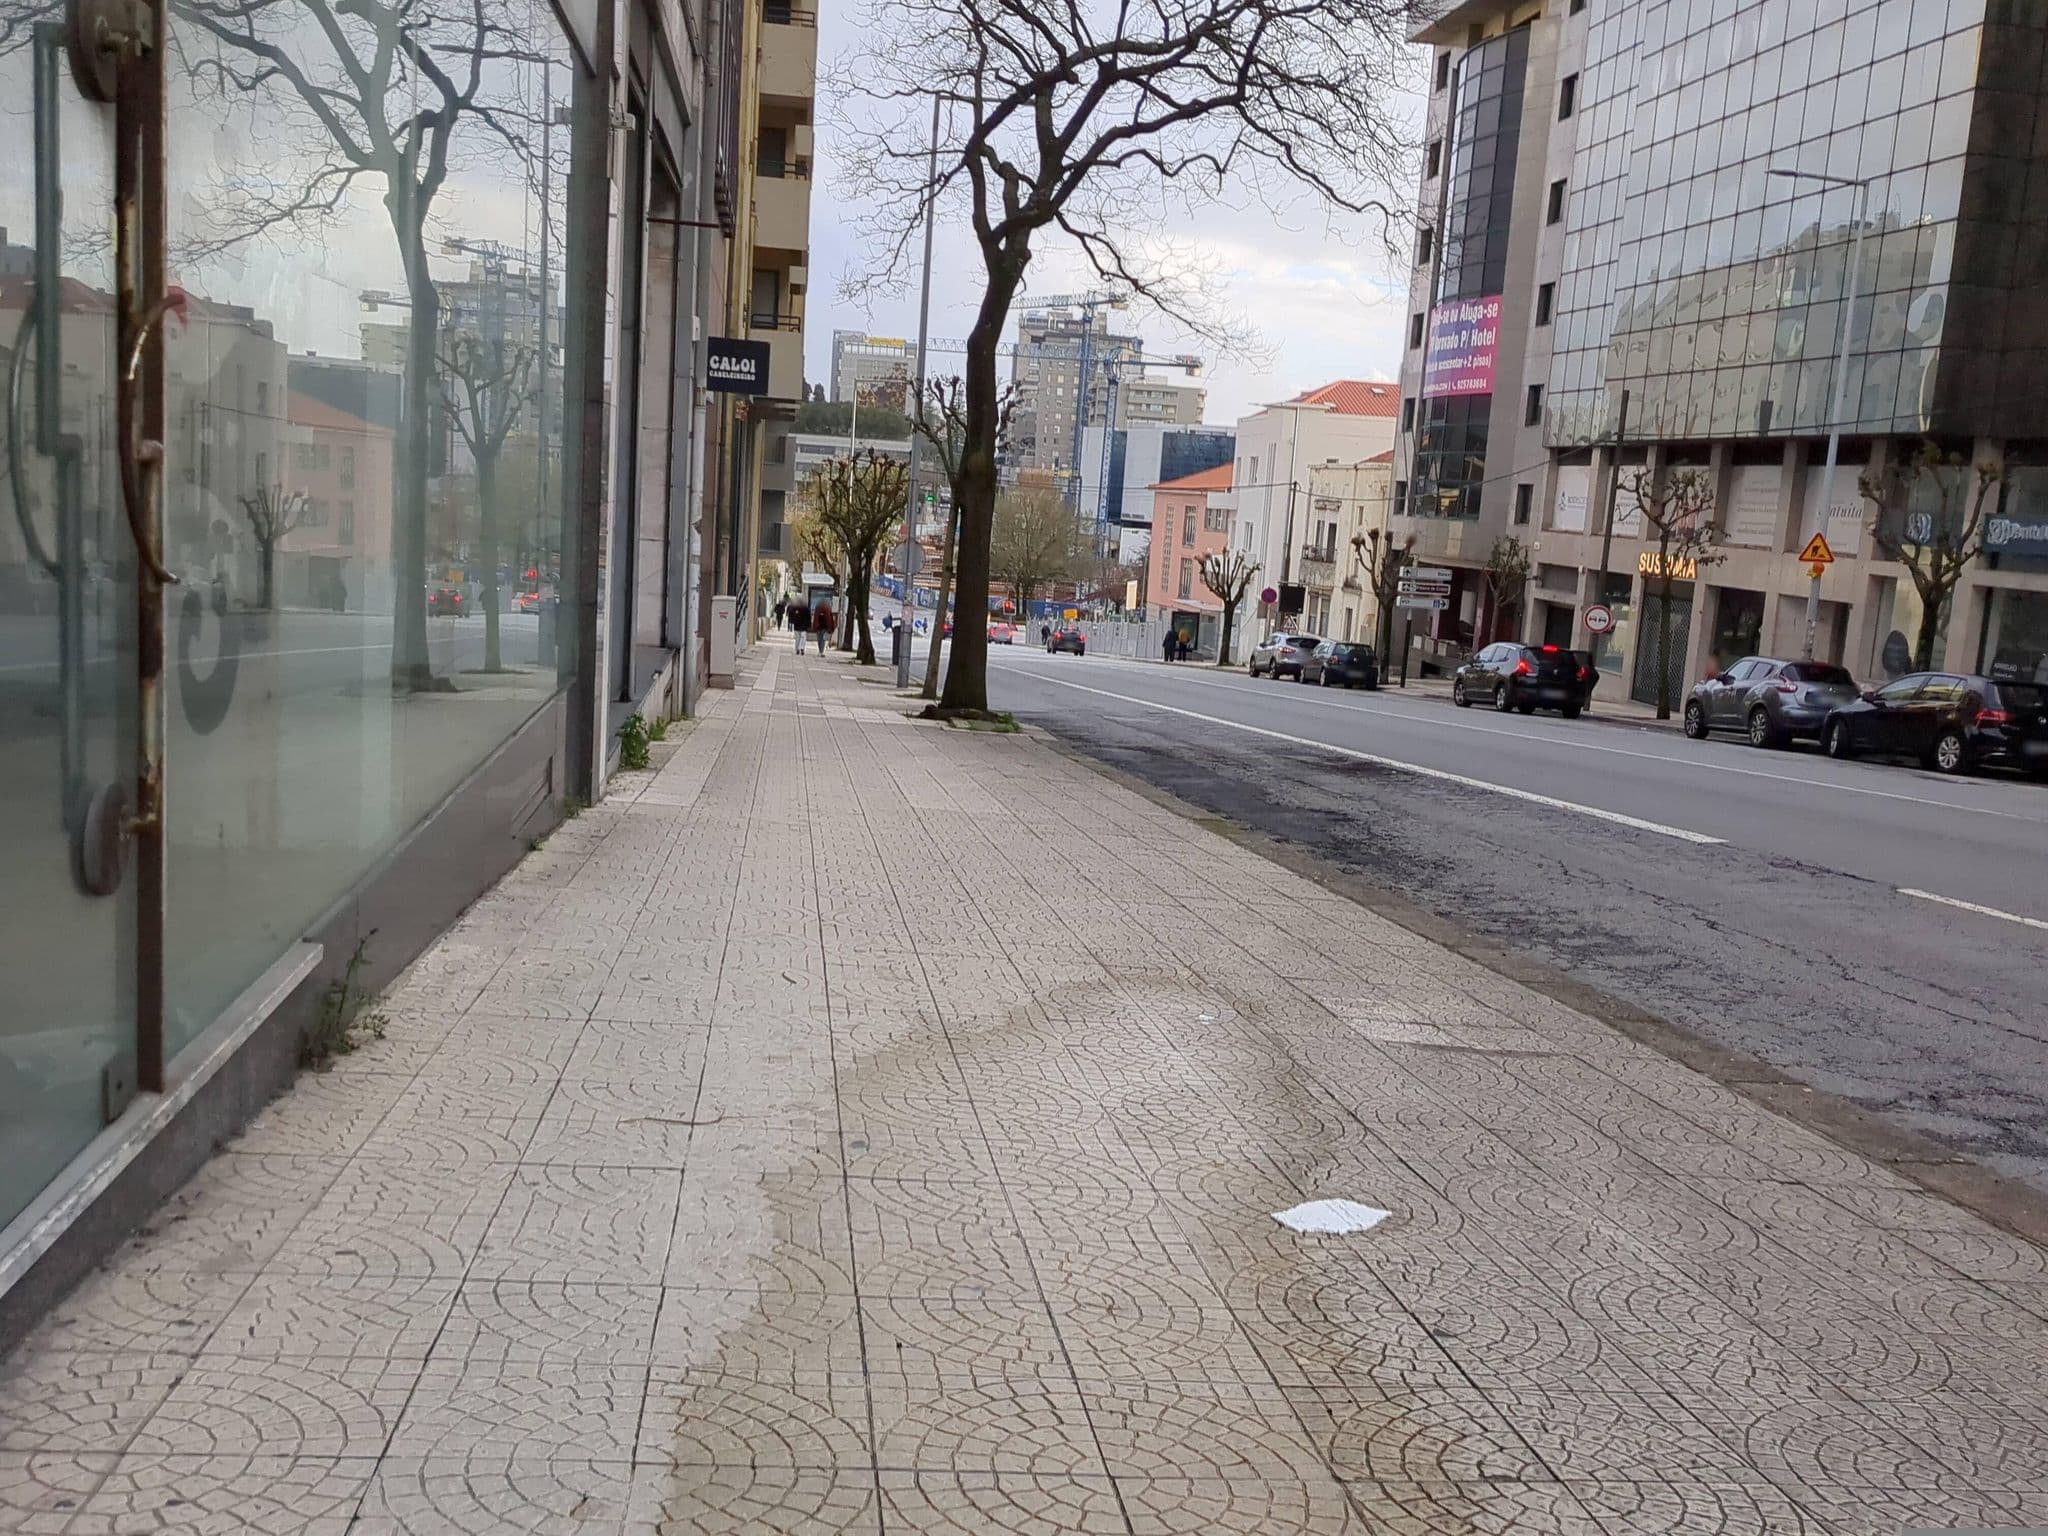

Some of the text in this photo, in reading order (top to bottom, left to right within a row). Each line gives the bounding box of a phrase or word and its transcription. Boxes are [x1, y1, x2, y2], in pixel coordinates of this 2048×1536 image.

[1460, 303, 1498, 324] Aluga-se
[1460, 330, 1469, 350] P/
[1471, 327, 1496, 348] Hotel
[710, 355, 755, 373] CALOI
[1818, 502, 1863, 520] atuita
